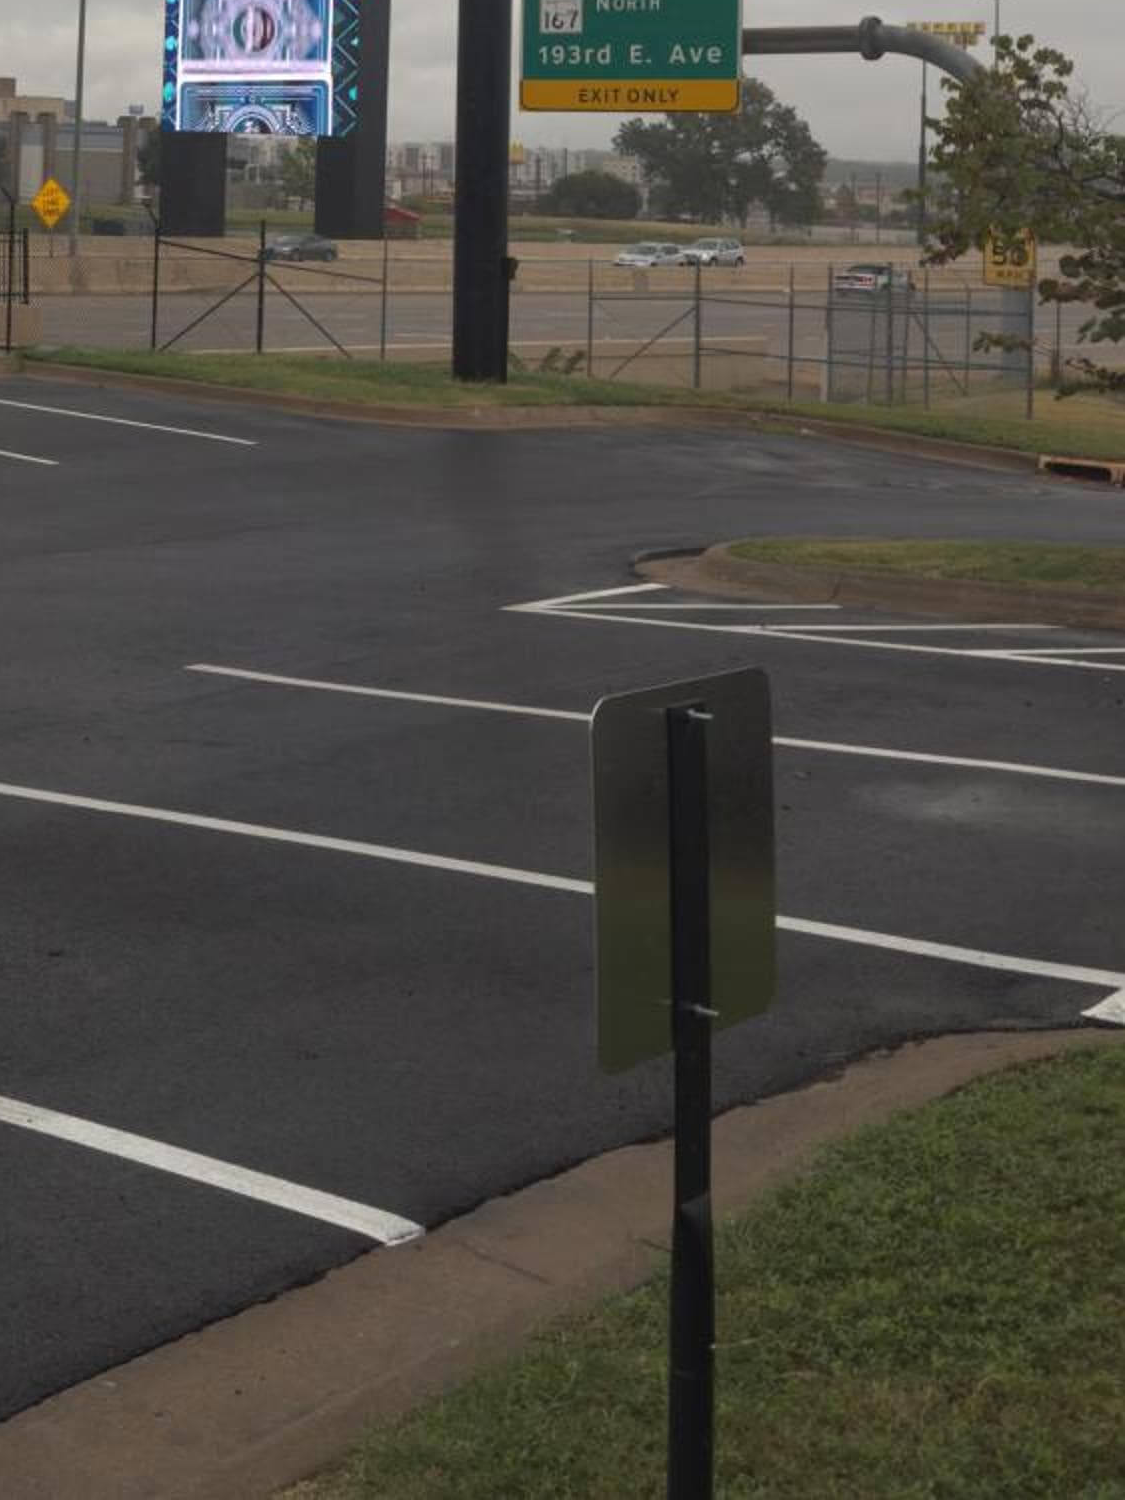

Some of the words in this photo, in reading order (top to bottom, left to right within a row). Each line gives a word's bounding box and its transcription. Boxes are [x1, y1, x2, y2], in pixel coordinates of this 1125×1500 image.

[544, 8, 579, 29] 167
[539, 45, 611, 65] 193rd
[630, 46, 652, 64] E.
[669, 45, 723, 65] Ave
[578, 89, 619, 104] EXIT
[627, 89, 679, 104] ONLY
